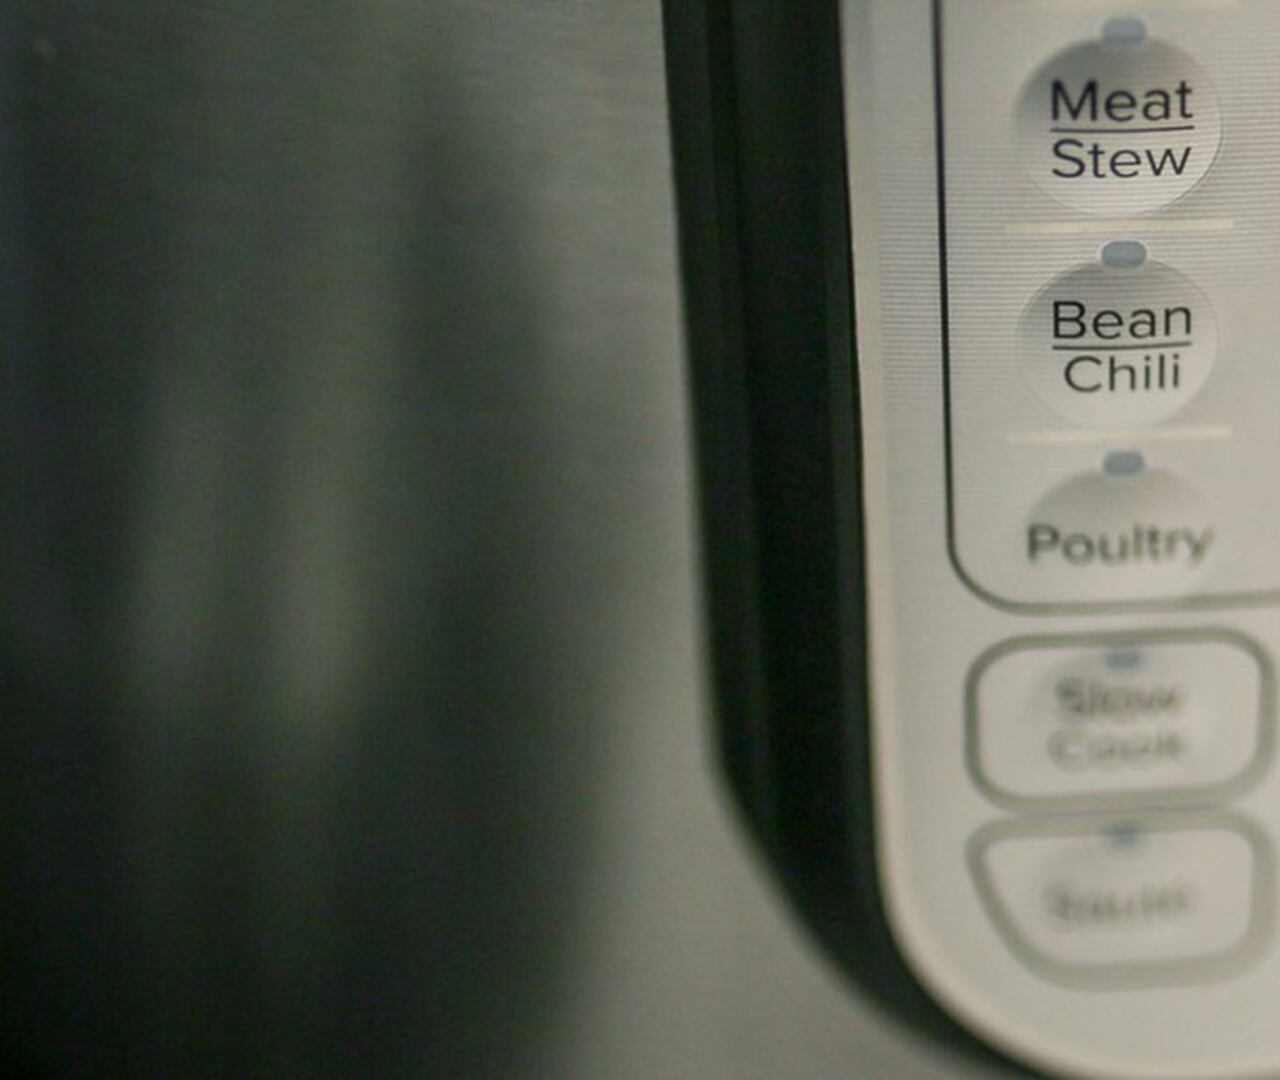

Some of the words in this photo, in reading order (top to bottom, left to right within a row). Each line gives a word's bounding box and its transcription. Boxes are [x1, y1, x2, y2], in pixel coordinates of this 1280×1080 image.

[1049, 79, 1195, 122] Meat
[1050, 137, 1192, 180] Stew
[1052, 299, 1193, 341] Bean
[1063, 352, 1182, 394] Chili
[1026, 522, 1215, 570] Poultry
